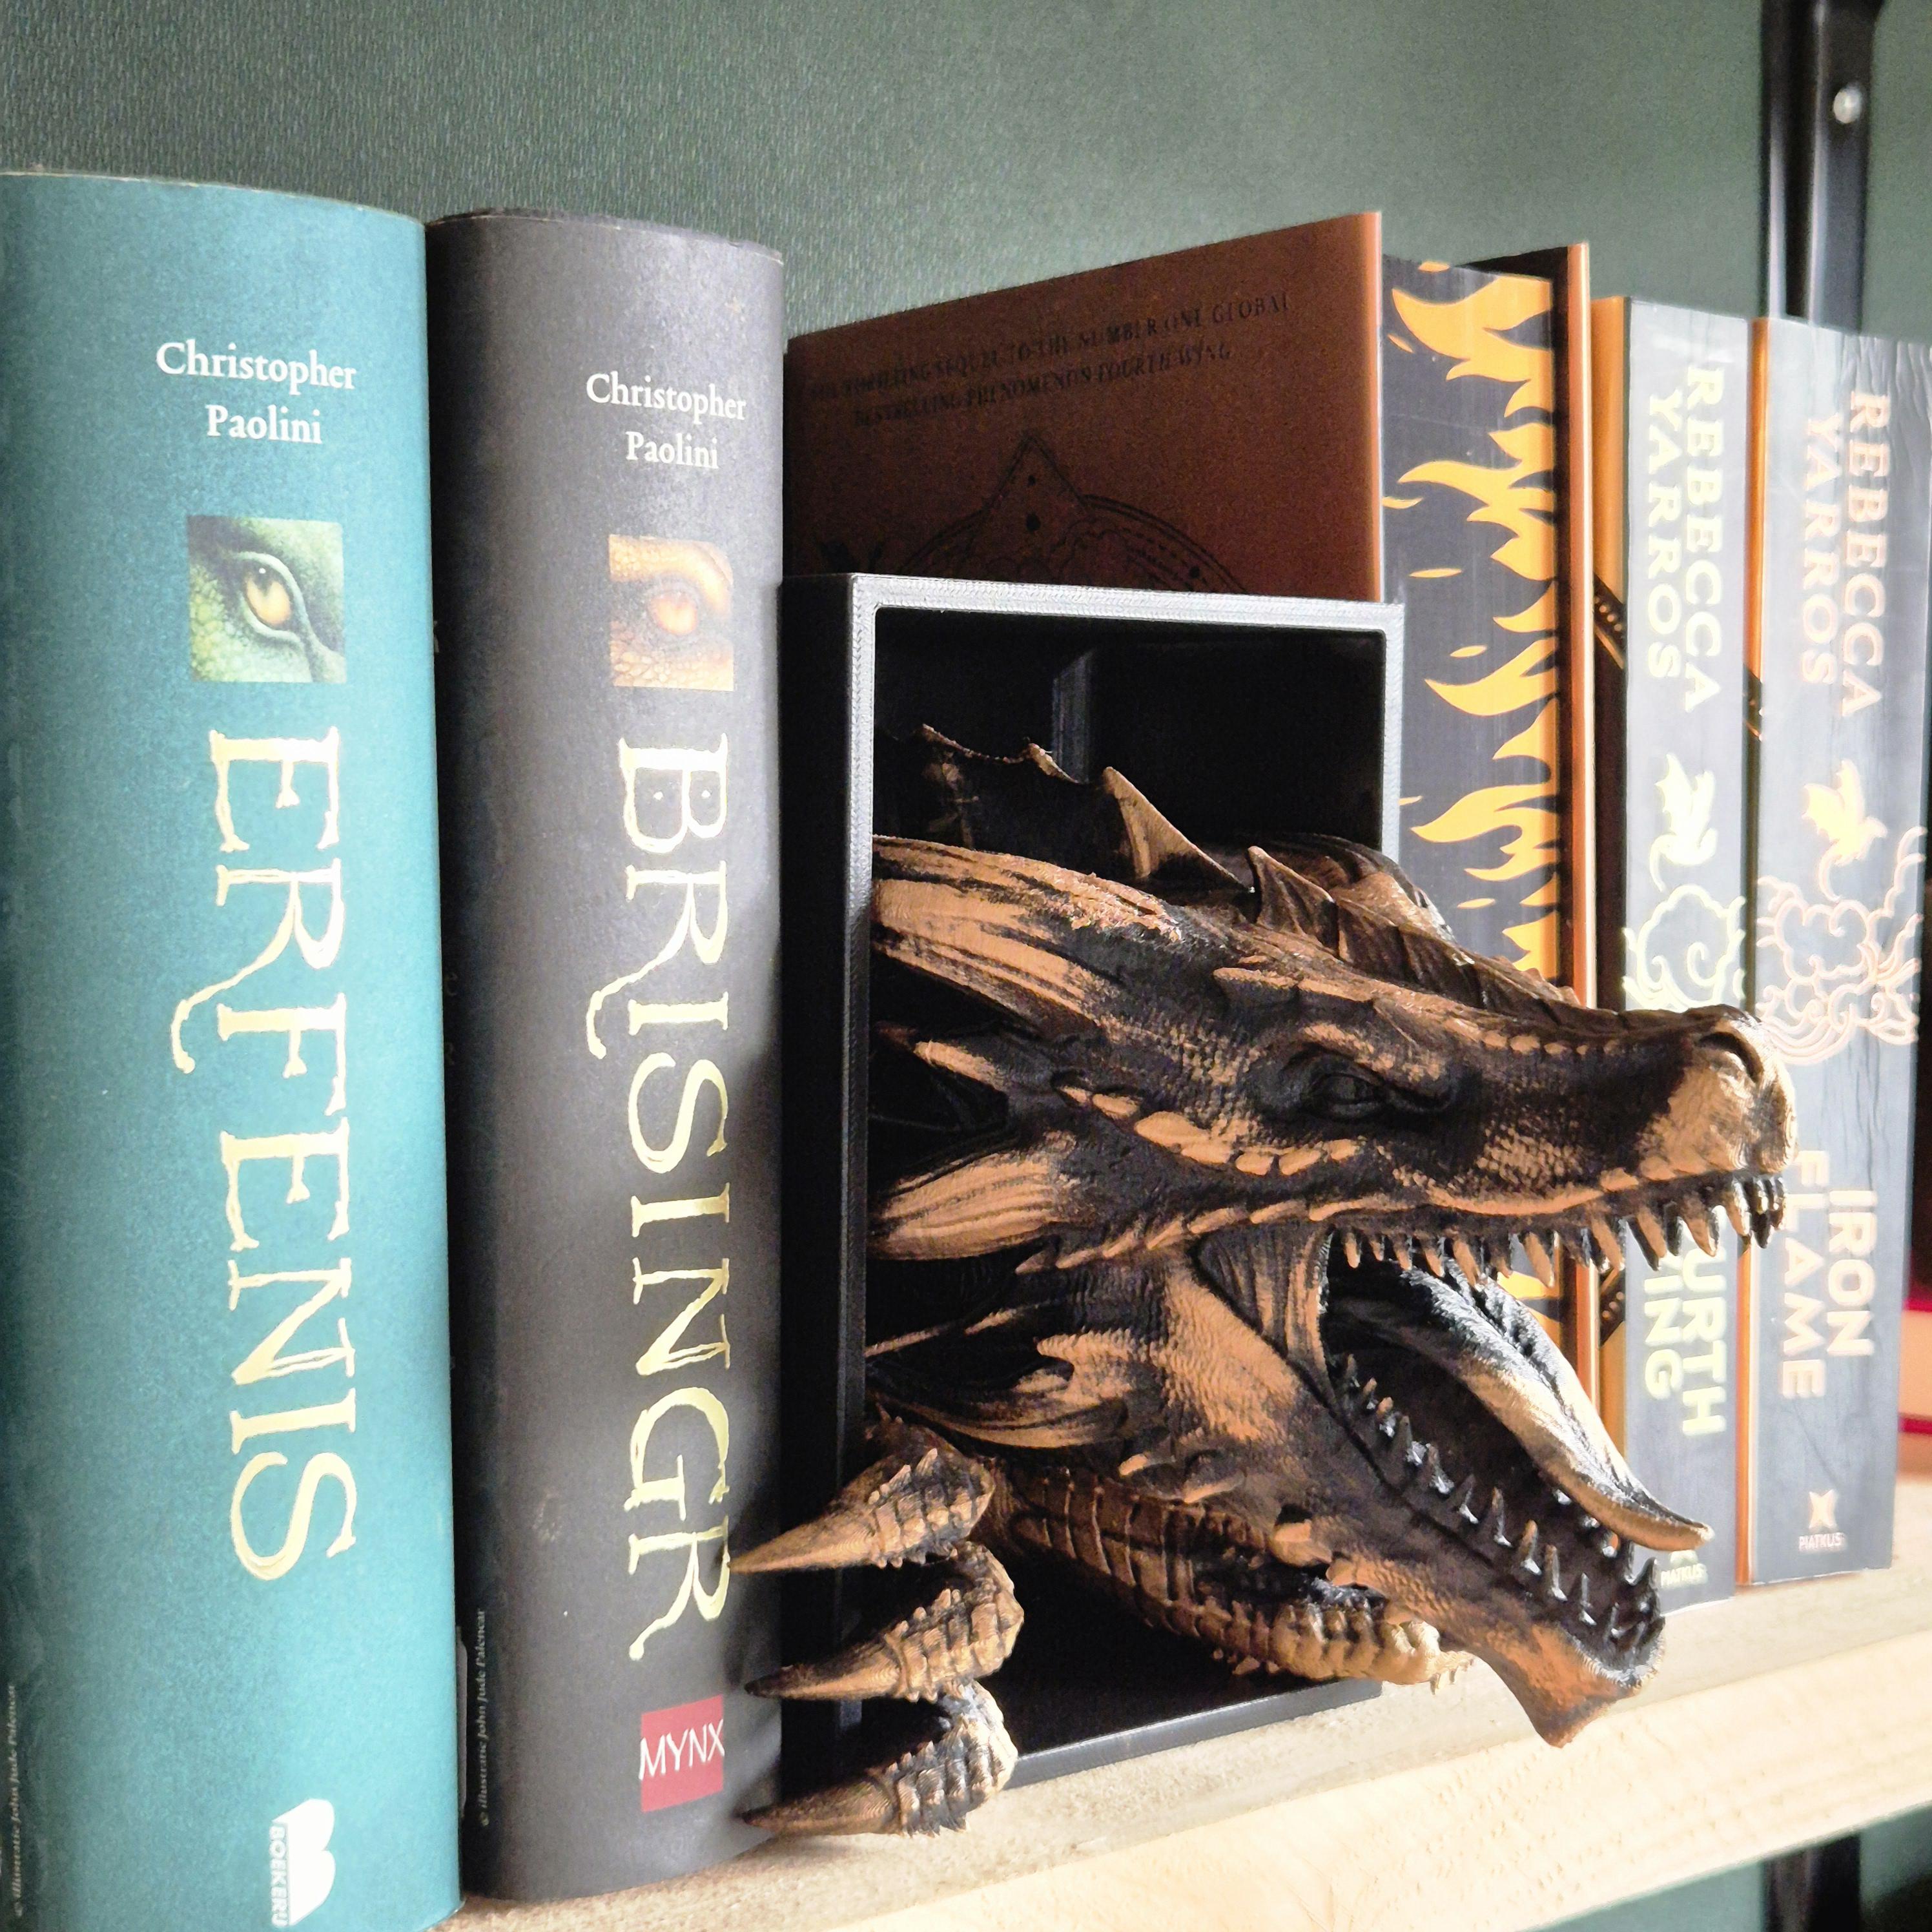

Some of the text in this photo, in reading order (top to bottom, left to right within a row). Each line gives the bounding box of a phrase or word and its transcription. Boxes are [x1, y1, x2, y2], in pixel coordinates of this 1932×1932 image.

[156, 339, 356, 396] Christopher
[206, 404, 322, 444] Paolini
[586, 371, 746, 425] Christopher
[625, 431, 719, 468] Paolini
[1647, 389, 1683, 680] YARROS
[1684, 366, 1724, 713] REBECCA
[1800, 412, 1845, 686] YARROS
[1842, 391, 1891, 717] REBECCA
[170, 726, 356, 1581] ERFENIS
[586, 732, 731, 1662] BRISINGR
[1644, 1250, 1683, 1400] ING
[1782, 1150, 1829, 1398] FLAME
[1827, 1190, 1878, 1355] IRON
[1798, 1532, 1845, 1551] PIATKUS
[475, 1705, 489, 1742] John
[638, 1718, 725, 1781] MYNX
